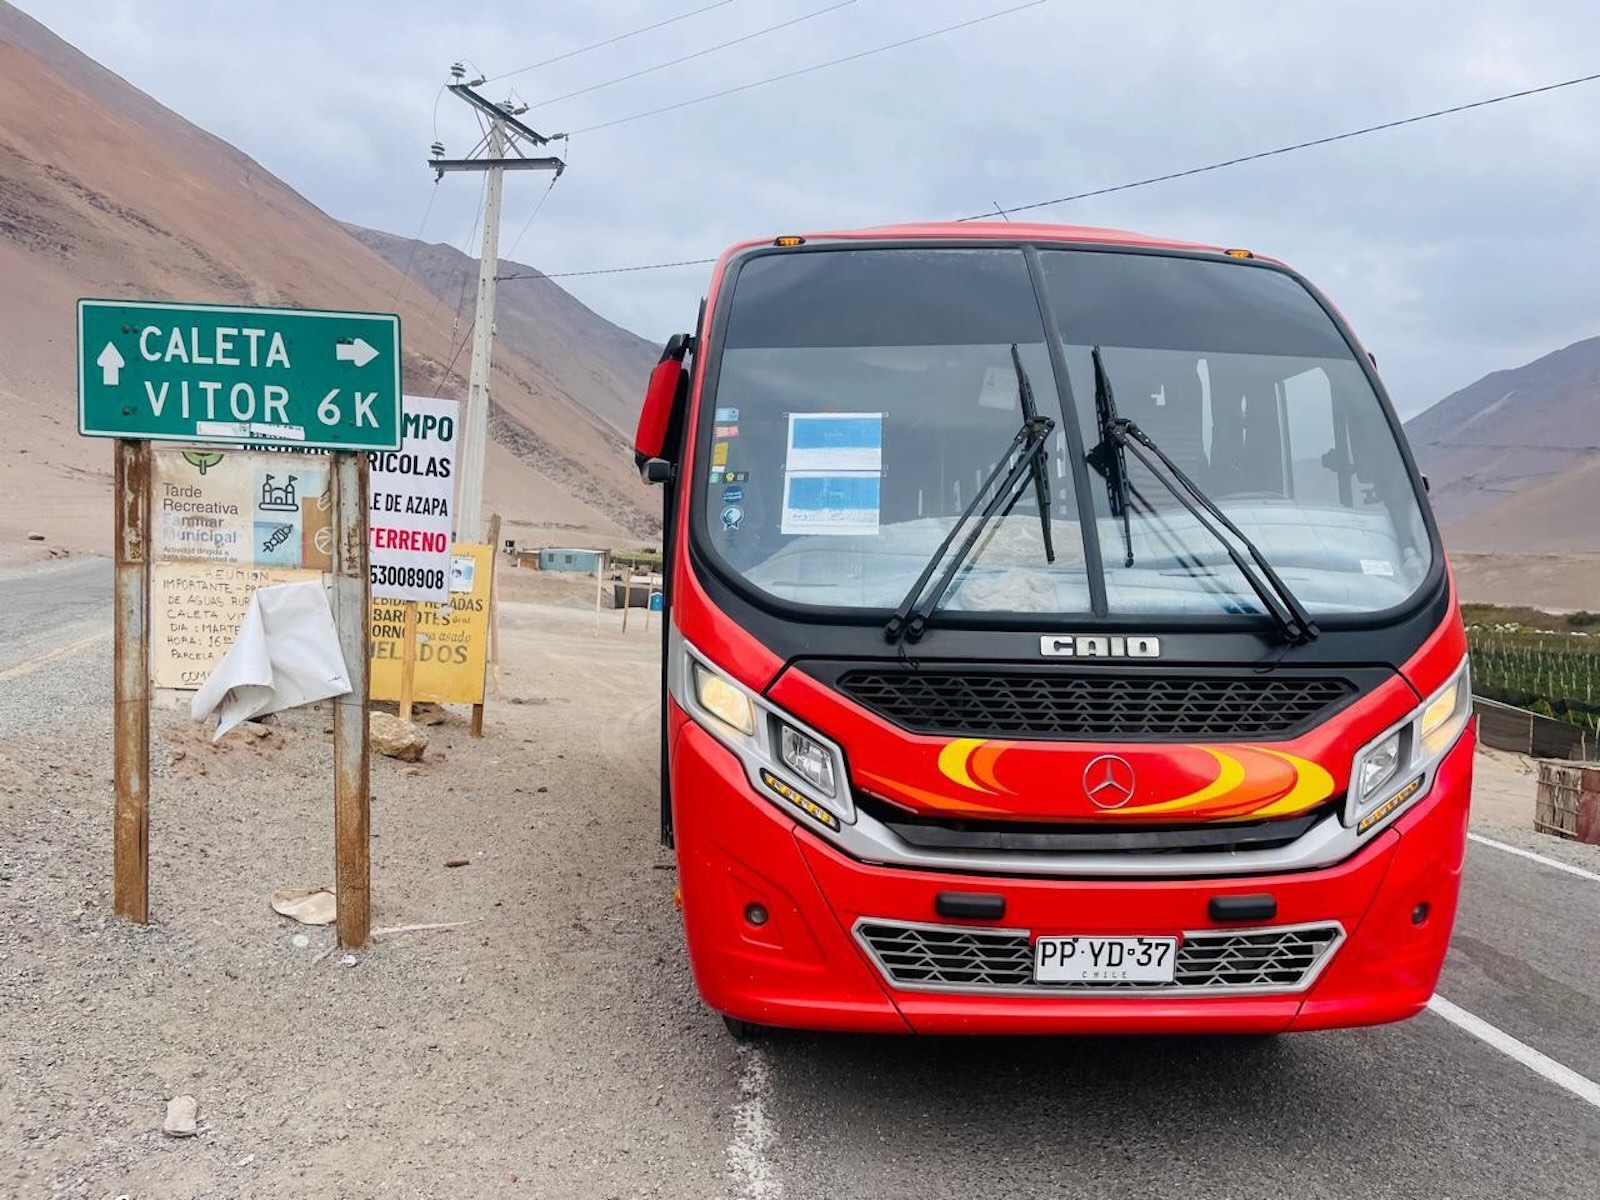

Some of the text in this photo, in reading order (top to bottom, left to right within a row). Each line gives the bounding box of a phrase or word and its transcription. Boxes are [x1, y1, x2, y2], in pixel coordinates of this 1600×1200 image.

[139, 325, 291, 369] CALETA
[144, 380, 380, 428] VITOR 6 K
[164, 482, 202, 498] Tarde
[163, 498, 239, 515] Recreativa
[369, 493, 448, 517] E DE AZAPA
[204, 569, 269, 581] EUNION
[370, 565, 444, 590] 53008908
[163, 579, 233, 594] IMPORTANTE
[168, 595, 181, 605] DE
[167, 609, 218, 619] CALETA
[373, 608, 451, 626] BAROTES
[170, 623, 188, 632] DIA
[372, 624, 406, 639] ORN
[370, 641, 468, 664] ELDOS
[1040, 636, 1160, 657] CAIO
[171, 648, 214, 661] PARCELA
[181, 671, 210, 683] COM
[1081, 971, 1128, 979] CHILE
